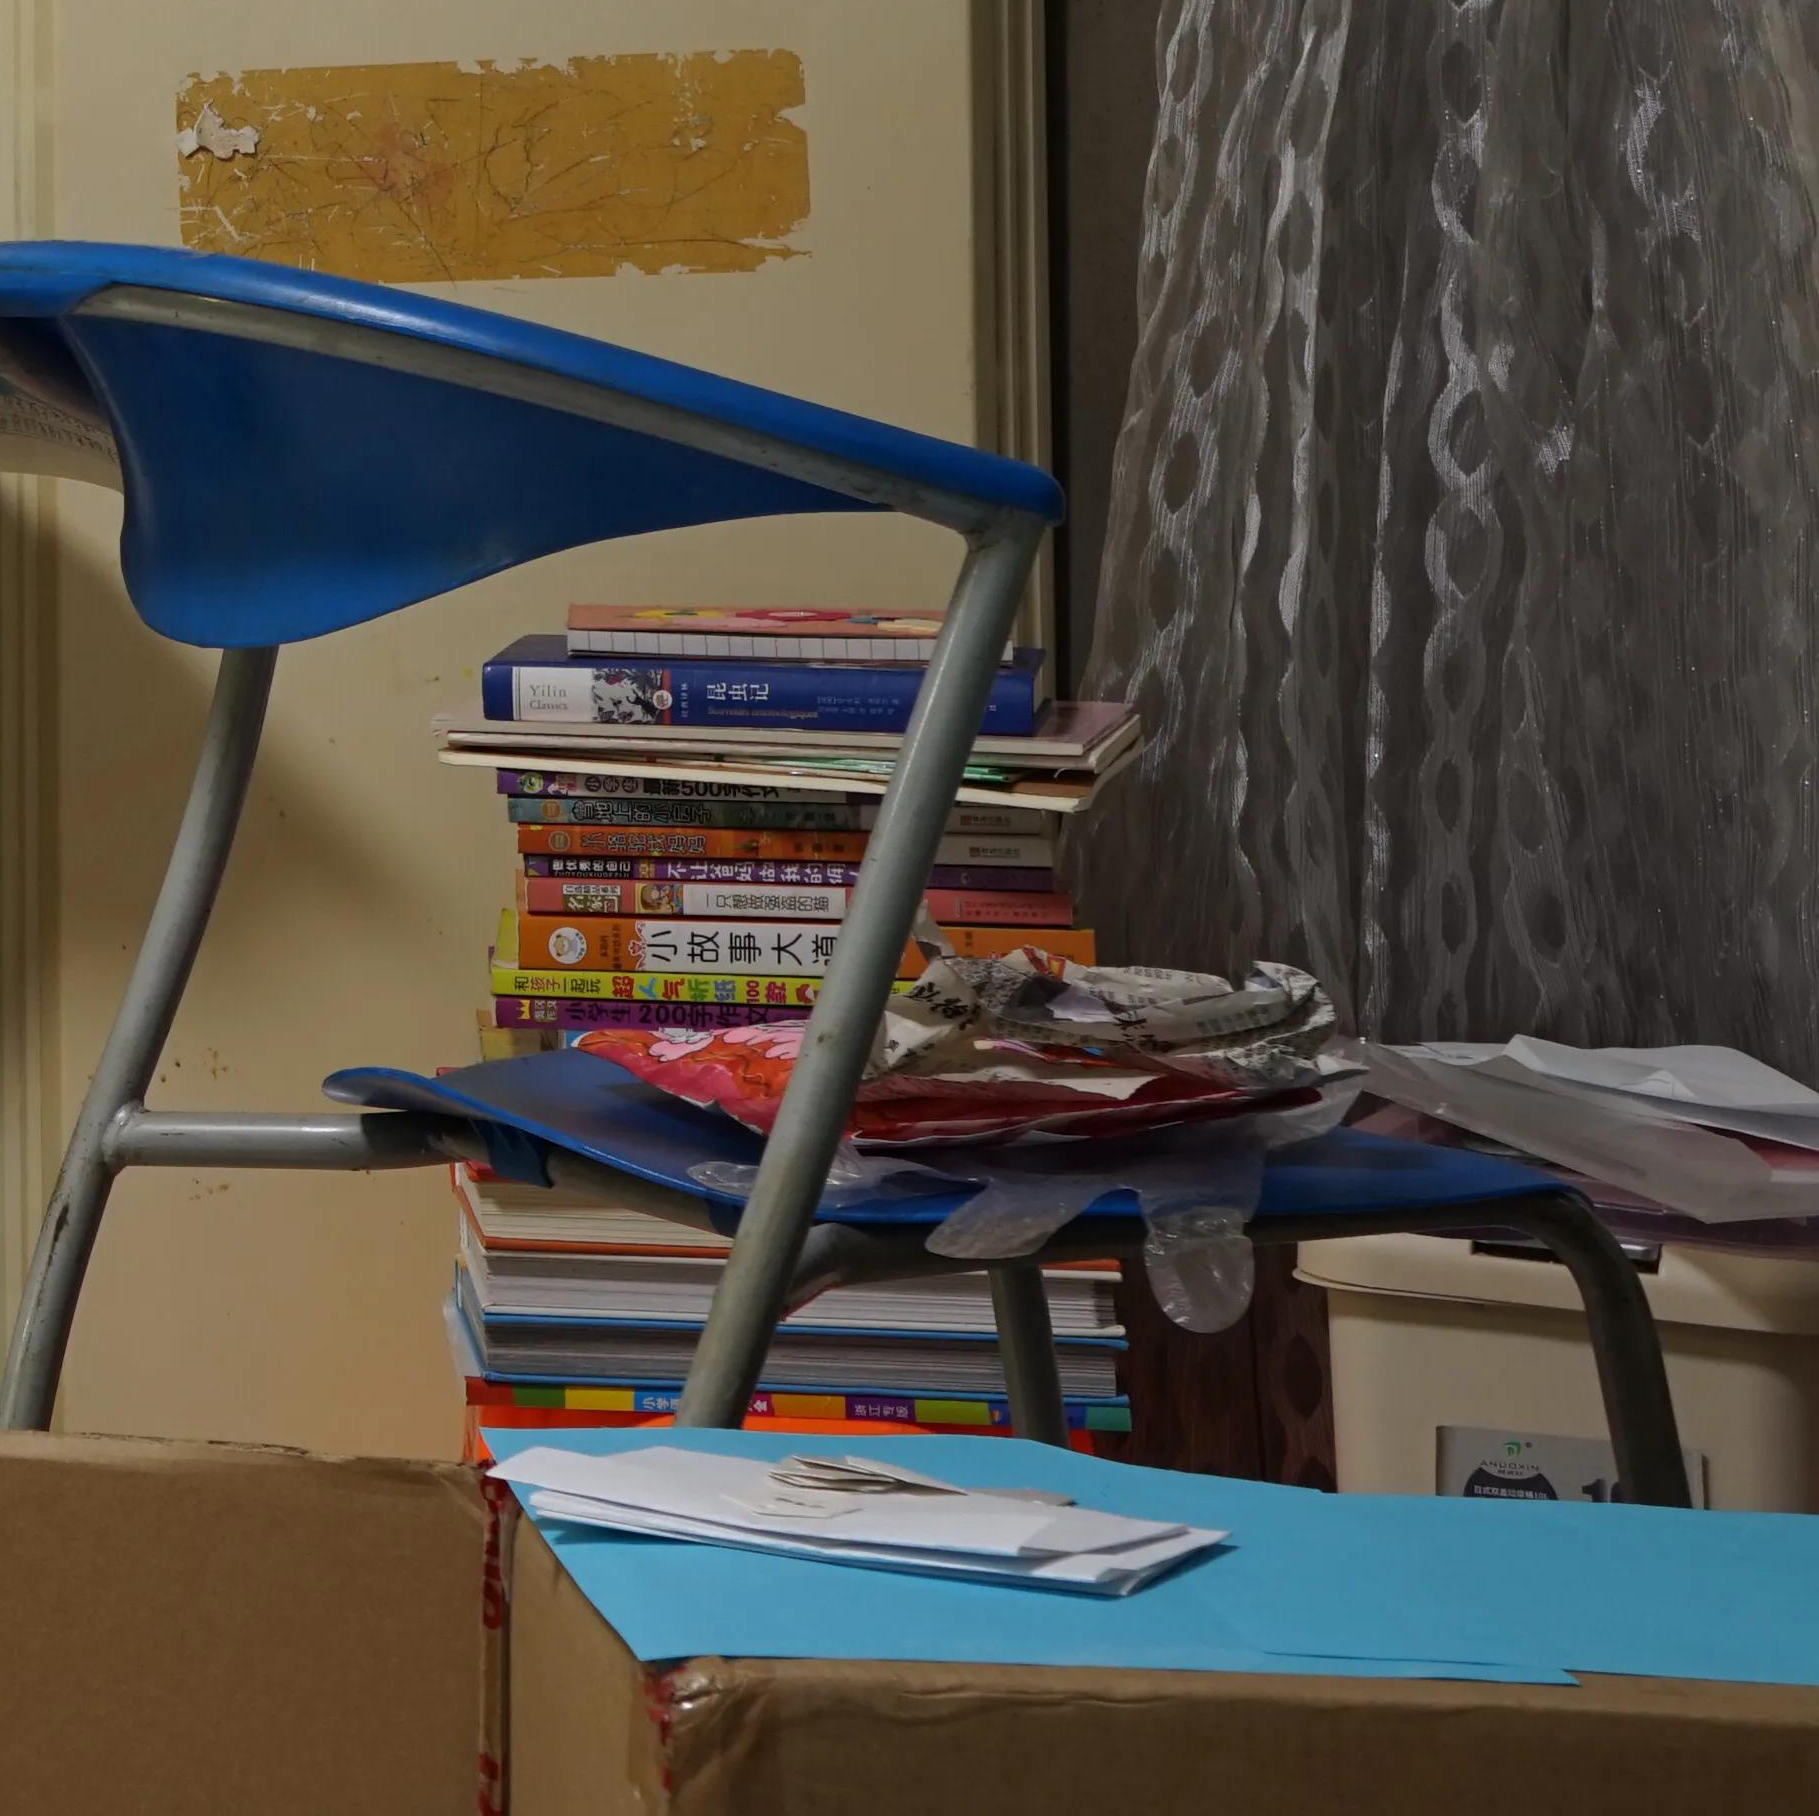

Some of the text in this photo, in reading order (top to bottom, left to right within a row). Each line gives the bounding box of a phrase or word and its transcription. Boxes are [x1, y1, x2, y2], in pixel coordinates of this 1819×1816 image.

[529, 685, 568, 699] Yilin
[706, 683, 770, 703] 昆虫记
[528, 699, 569, 713] Classics
[667, 861, 860, 885] 不让爸妈做我的佣
[705, 892, 830, 913] 一只想做强盗的猫
[513, 975, 788, 1005] 和孩子一起玩 超人气折纸100款
[566, 1002, 771, 1030] 小学生200字作文
